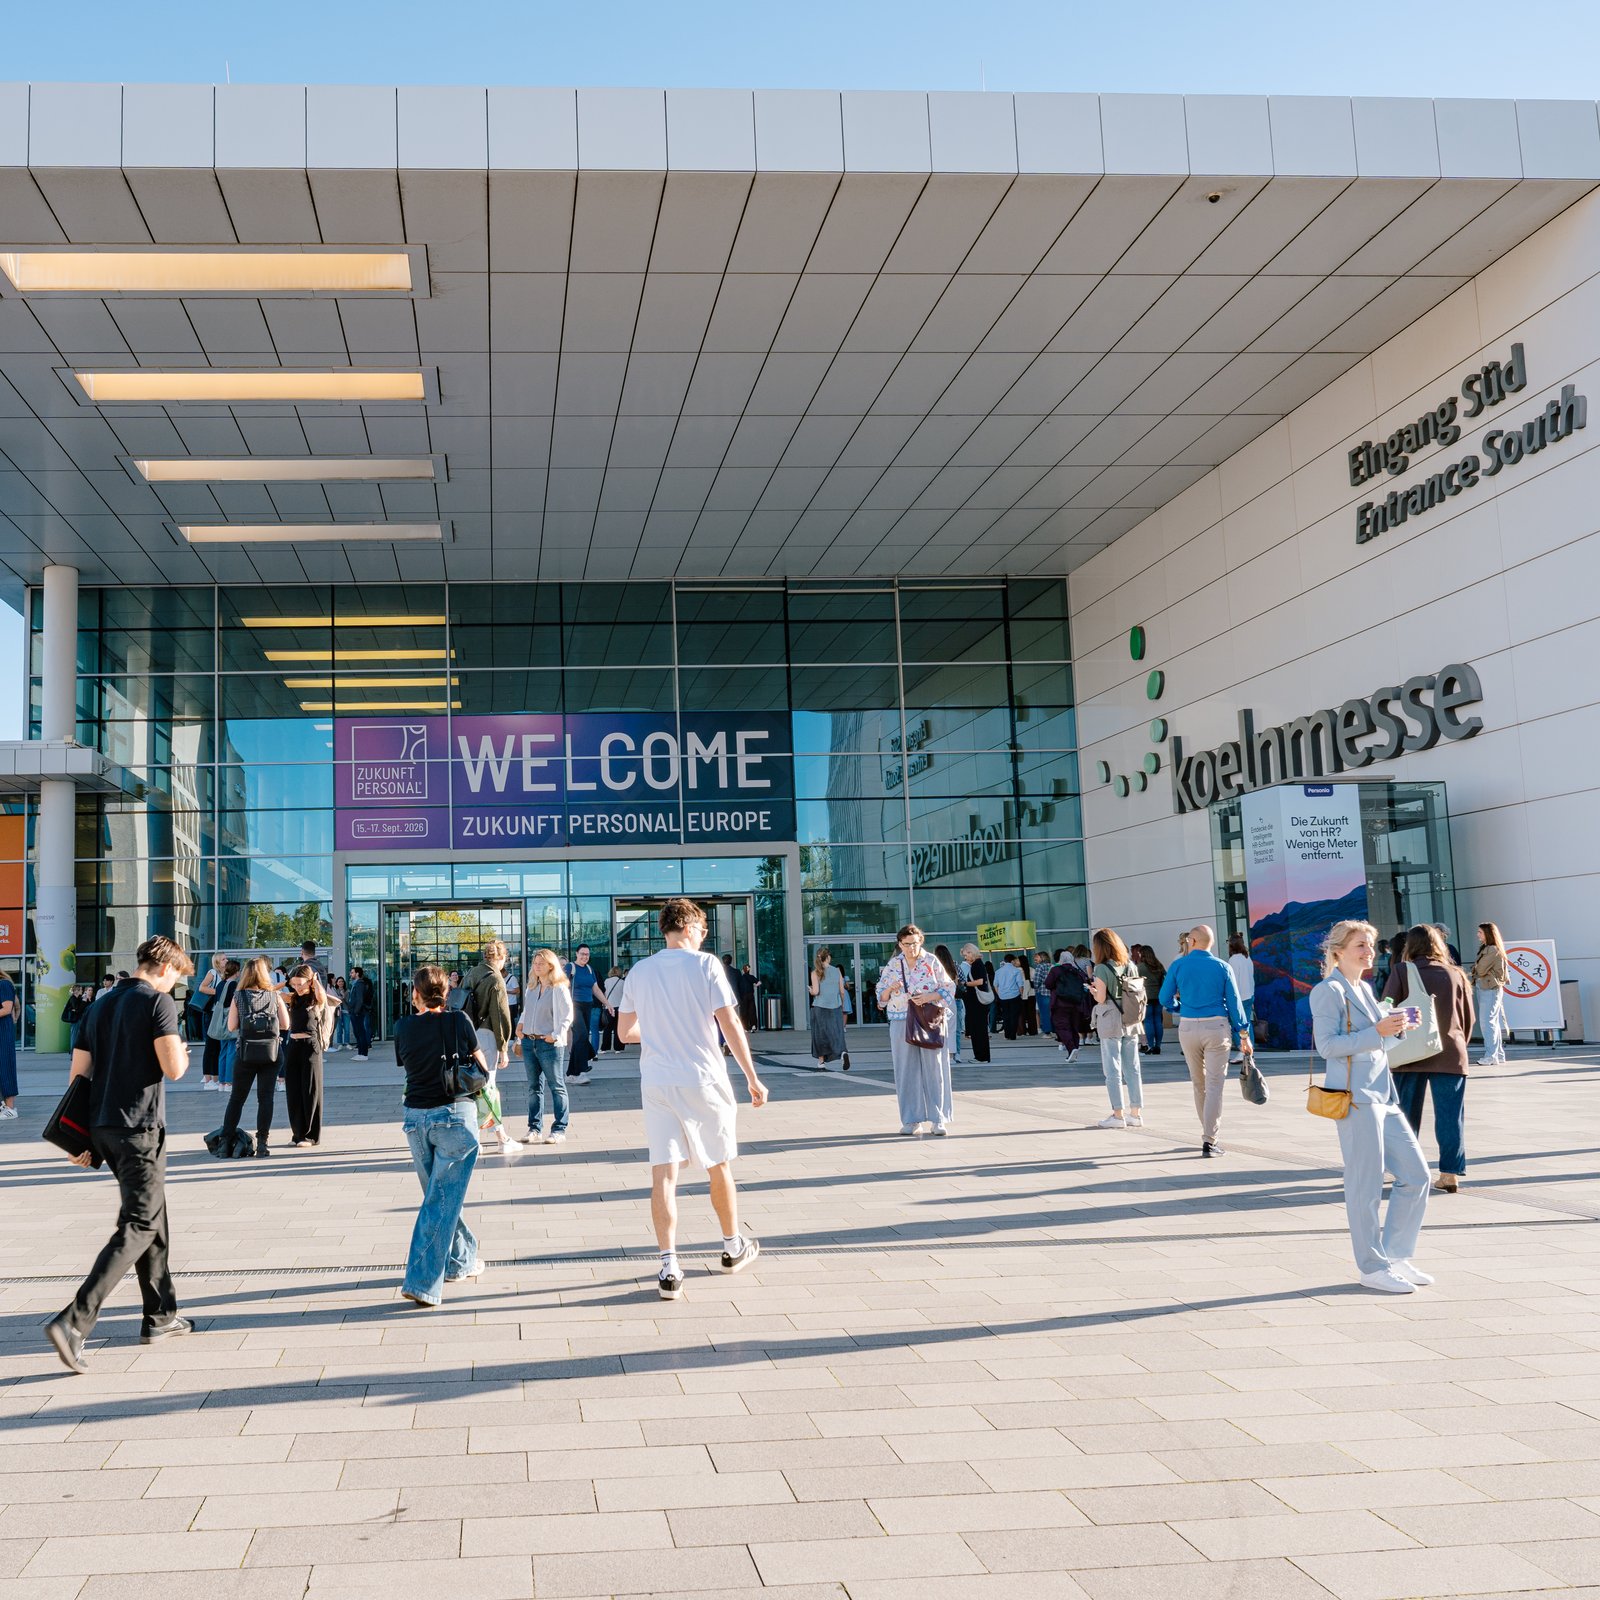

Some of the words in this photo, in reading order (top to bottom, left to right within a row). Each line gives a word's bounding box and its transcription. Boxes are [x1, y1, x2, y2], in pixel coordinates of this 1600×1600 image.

[1348, 396, 1461, 486] Eingang
[1461, 342, 1527, 417] Süd
[1356, 455, 1480, 544] Entrance
[1482, 384, 1587, 476] South
[1169, 663, 1484, 814] koelnmesse
[457, 730, 771, 793] WELCOME
[357, 766, 415, 780] ZUKUNFT
[462, 815, 562, 836] ZUKUNFT
[569, 812, 681, 834] PERSONAL
[687, 811, 772, 832] EUROPE
[1290, 816, 1308, 826] Die
[1310, 815, 1349, 826] Zukunft
[382, 823, 402, 834] Sept.
[404, 823, 424, 832] 2026
[1299, 829, 1319, 837] von
[1321, 827, 1342, 837] HR?
[1285, 839, 1326, 850] Wenige
[1327, 838, 1358, 848] Meter
[1301, 850, 1344, 860] entfernt.
[980, 927, 1006, 941] TALENTE?
